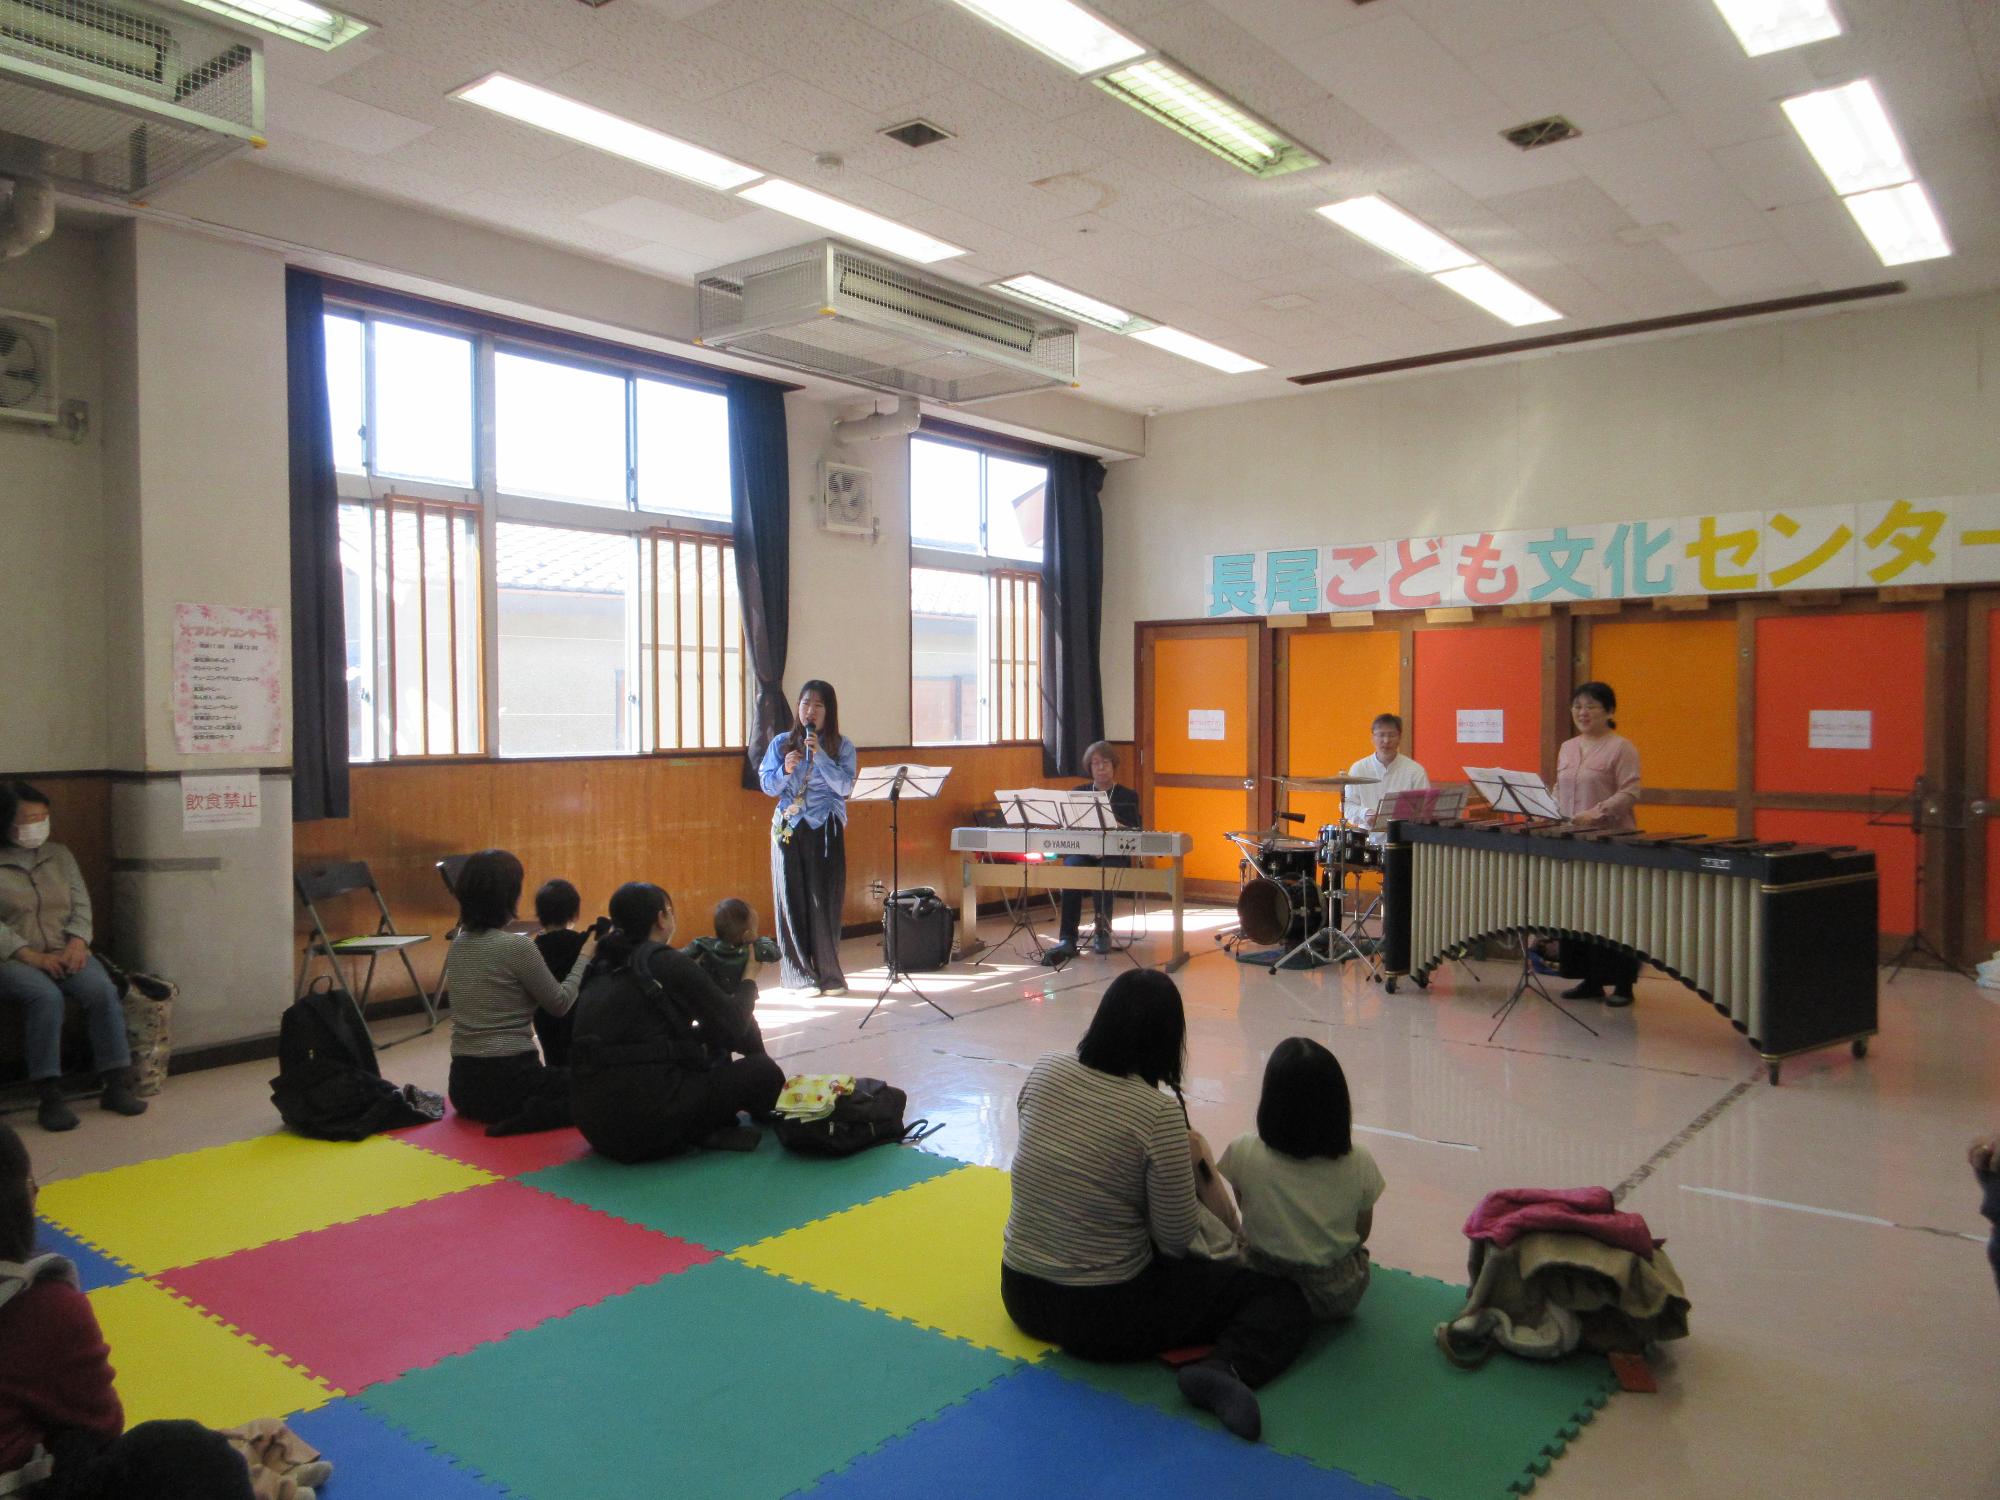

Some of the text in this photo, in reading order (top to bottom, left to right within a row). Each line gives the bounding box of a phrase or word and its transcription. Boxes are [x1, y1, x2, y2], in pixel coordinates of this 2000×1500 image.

[185, 791, 259, 811] 飲食禁止
[1052, 840, 1080, 849] YAMAHA
